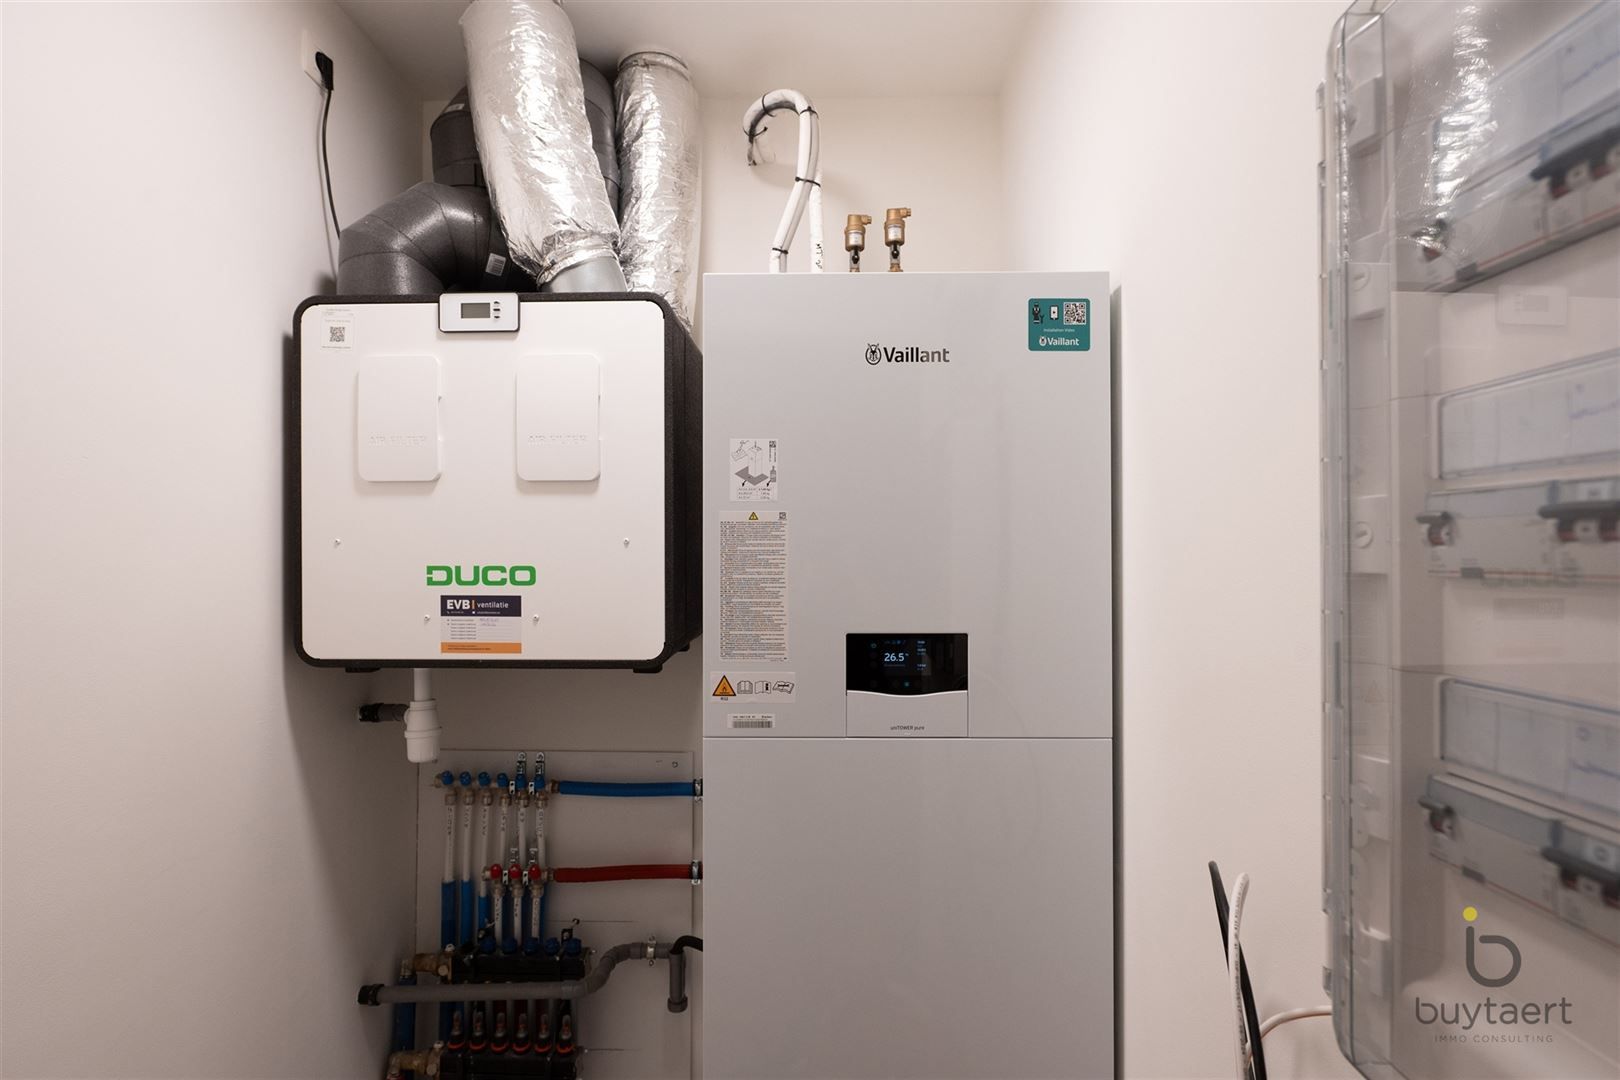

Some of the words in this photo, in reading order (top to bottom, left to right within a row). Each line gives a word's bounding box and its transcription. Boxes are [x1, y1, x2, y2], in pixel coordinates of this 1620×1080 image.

[1047, 337, 1080, 346] Vaillant
[883, 346, 950, 363] Vaillant
[426, 565, 537, 586] DUCO
[446, 599, 471, 610] EVB
[477, 601, 509, 609] ventilatie
